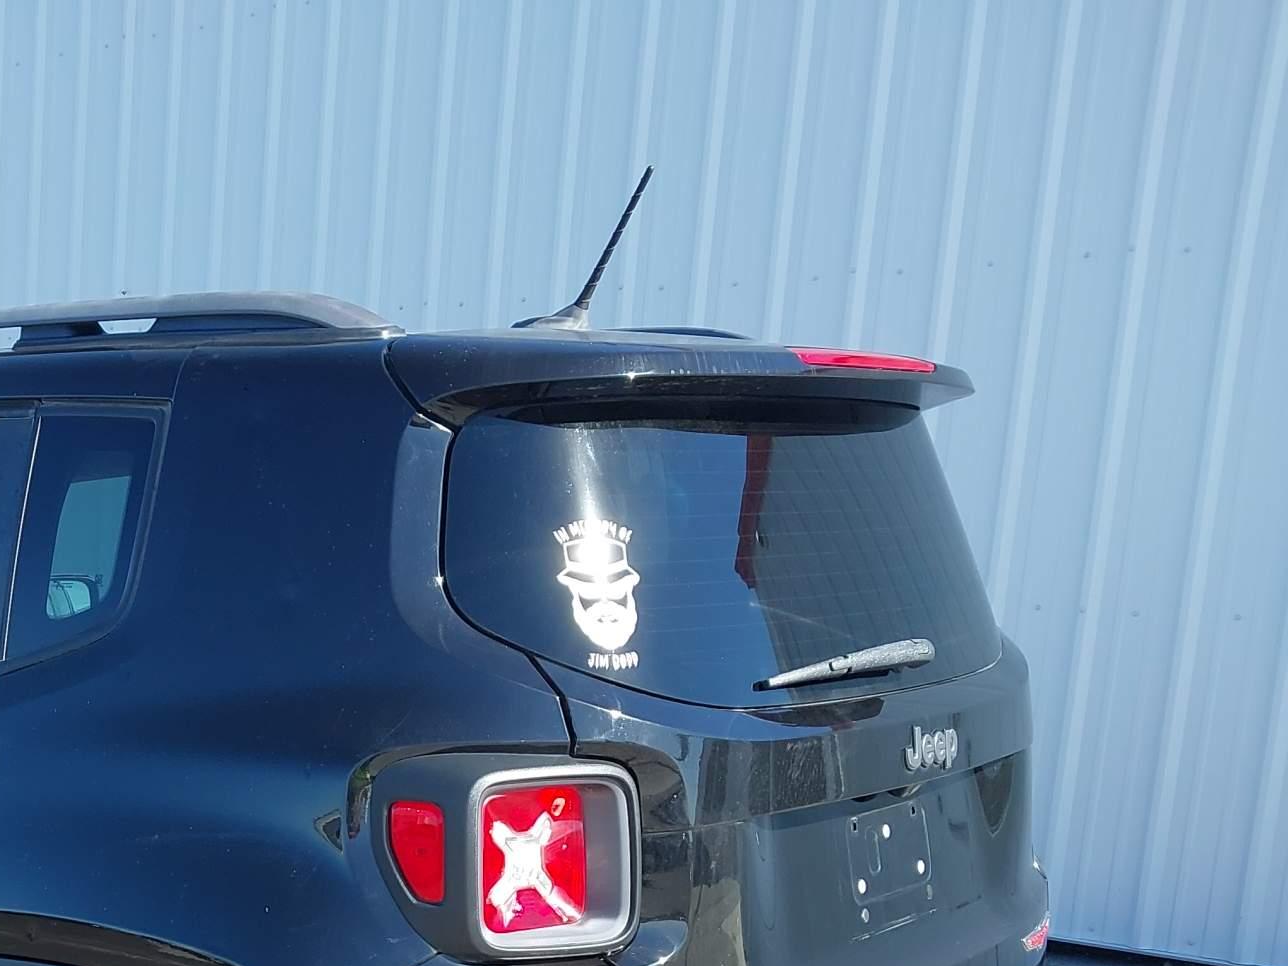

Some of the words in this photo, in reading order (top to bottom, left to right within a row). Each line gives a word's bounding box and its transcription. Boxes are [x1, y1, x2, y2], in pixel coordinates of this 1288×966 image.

[567, 519, 618, 539] MERY
[587, 652, 610, 671] JIM
[904, 725, 958, 771] Jeep
